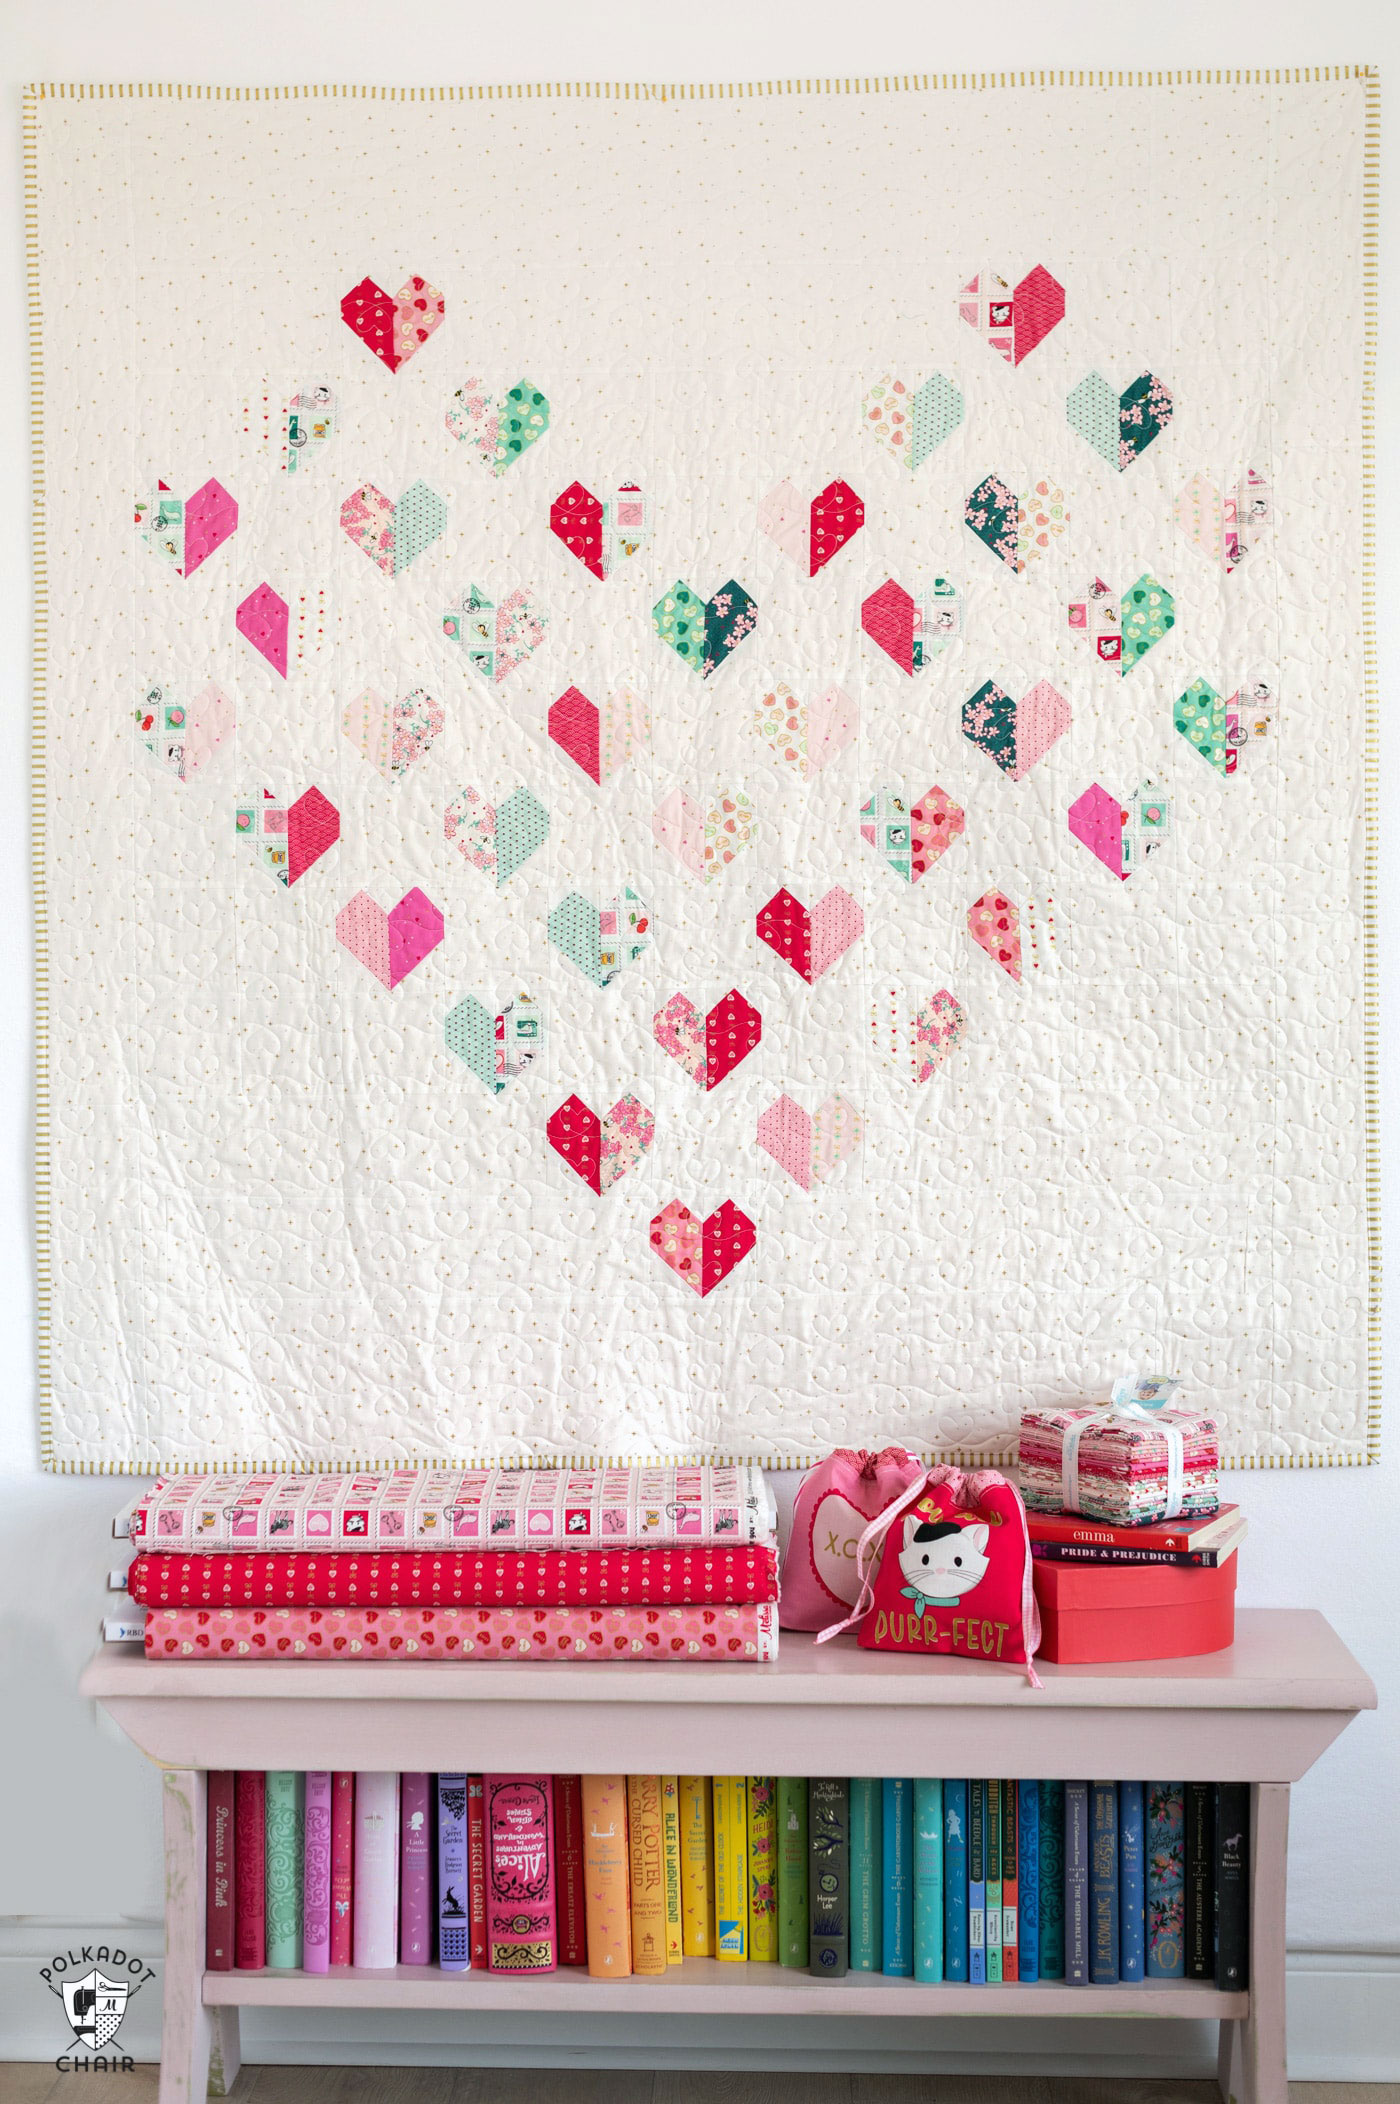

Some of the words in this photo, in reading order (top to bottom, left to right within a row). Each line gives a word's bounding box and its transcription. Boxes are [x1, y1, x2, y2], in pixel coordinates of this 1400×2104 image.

[1073, 1530, 1114, 1543] emma
[1061, 1547, 1097, 1558] PRIDE
[1099, 1548, 1108, 1558] &
[1112, 1549, 1177, 1562] PREJUDICE
[874, 1610, 1010, 1658] PURR-FECT
[641, 1775, 660, 1818] ARRY
[973, 1785, 982, 1807] TALES
[215, 1806, 229, 1857] Princess
[471, 1818, 483, 1838] THE
[632, 1799, 643, 1845] CURSED
[753, 1820, 773, 1834] HEIDI
[973, 1818, 982, 1846] BEEDLE
[1006, 1816, 1014, 1843] BEASTS
[442, 1837, 463, 1845] Garden
[215, 1861, 227, 1873] in
[471, 1842, 483, 1879] SECRET
[495, 1852, 546, 1881] Alice's
[632, 1848, 644, 1887] CHILD
[644, 1824, 661, 1892] POTTER
[973, 1858, 982, 1878] BARD
[1098, 1834, 1113, 1878] BEASTS
[1222, 1860, 1241, 1868] Beauty
[215, 1877, 229, 1908] Pink
[472, 1884, 484, 1923] GARDEN
[817, 1894, 838, 1904] Harper
[822, 1902, 833, 1910] Lee
[568, 1909, 576, 1944] ELEVATOR
[1097, 1898, 1111, 1946] ROWLING
[1074, 1940, 1082, 1958] MILL
[1098, 1947, 1112, 1963] JK
